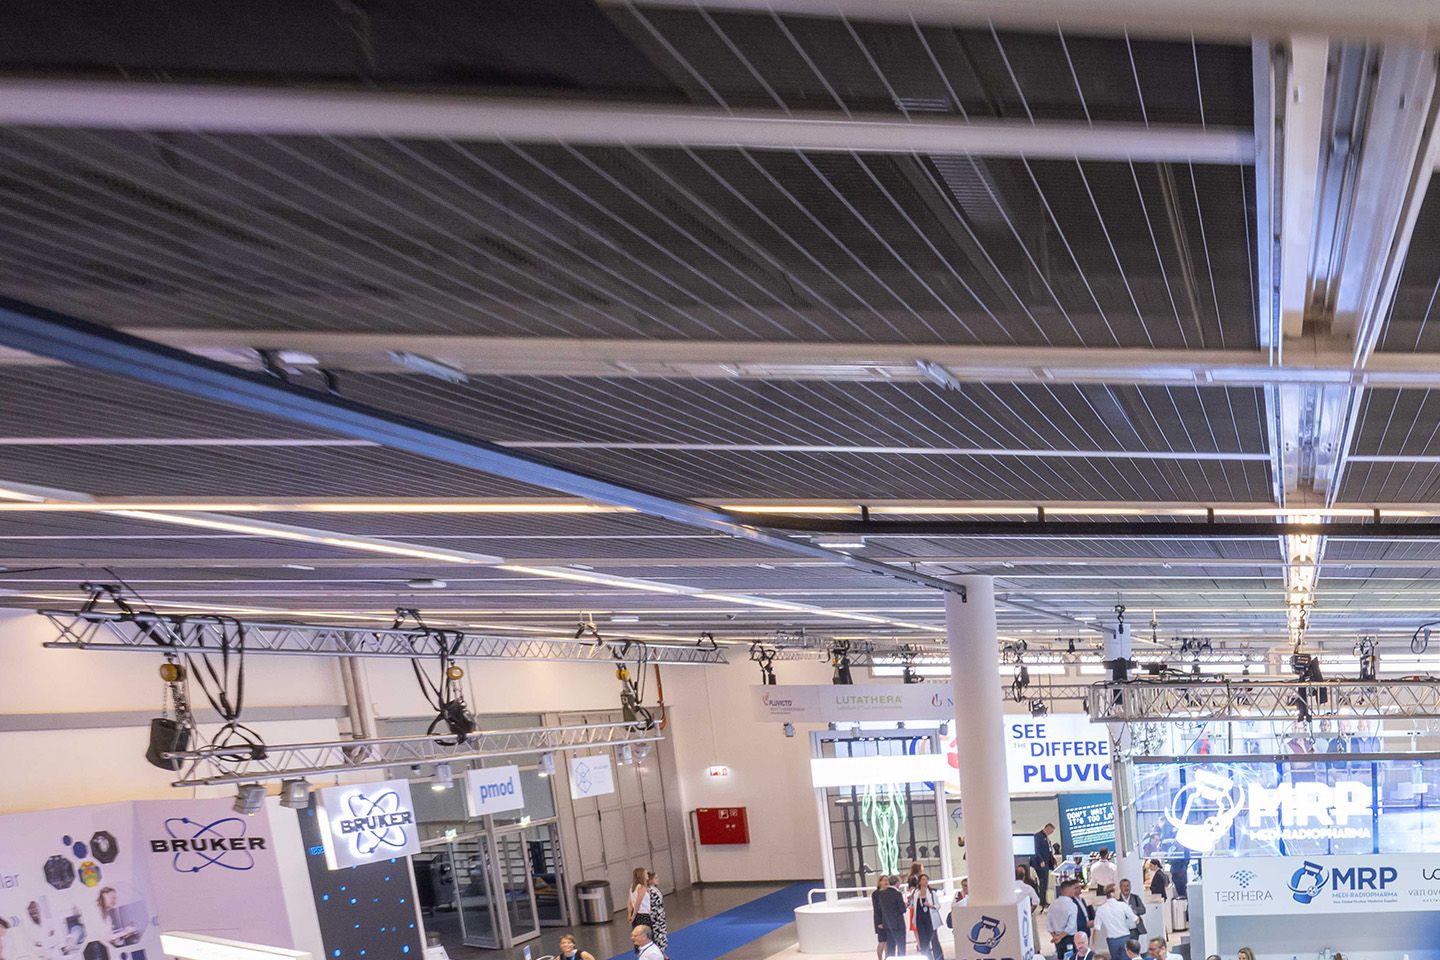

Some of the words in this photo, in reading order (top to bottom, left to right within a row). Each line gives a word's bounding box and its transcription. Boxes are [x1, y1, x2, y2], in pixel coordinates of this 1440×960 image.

[836, 695, 902, 705] LUTATHERA
[1012, 723, 1047, 739] SEE
[480, 776, 515, 804] pmod
[1248, 781, 1372, 826] MRP
[341, 811, 413, 834] BRUKER
[151, 837, 267, 852] BRUKER
[1332, 866, 1398, 890] MRP
[1215, 889, 1274, 902] TERTHERA
